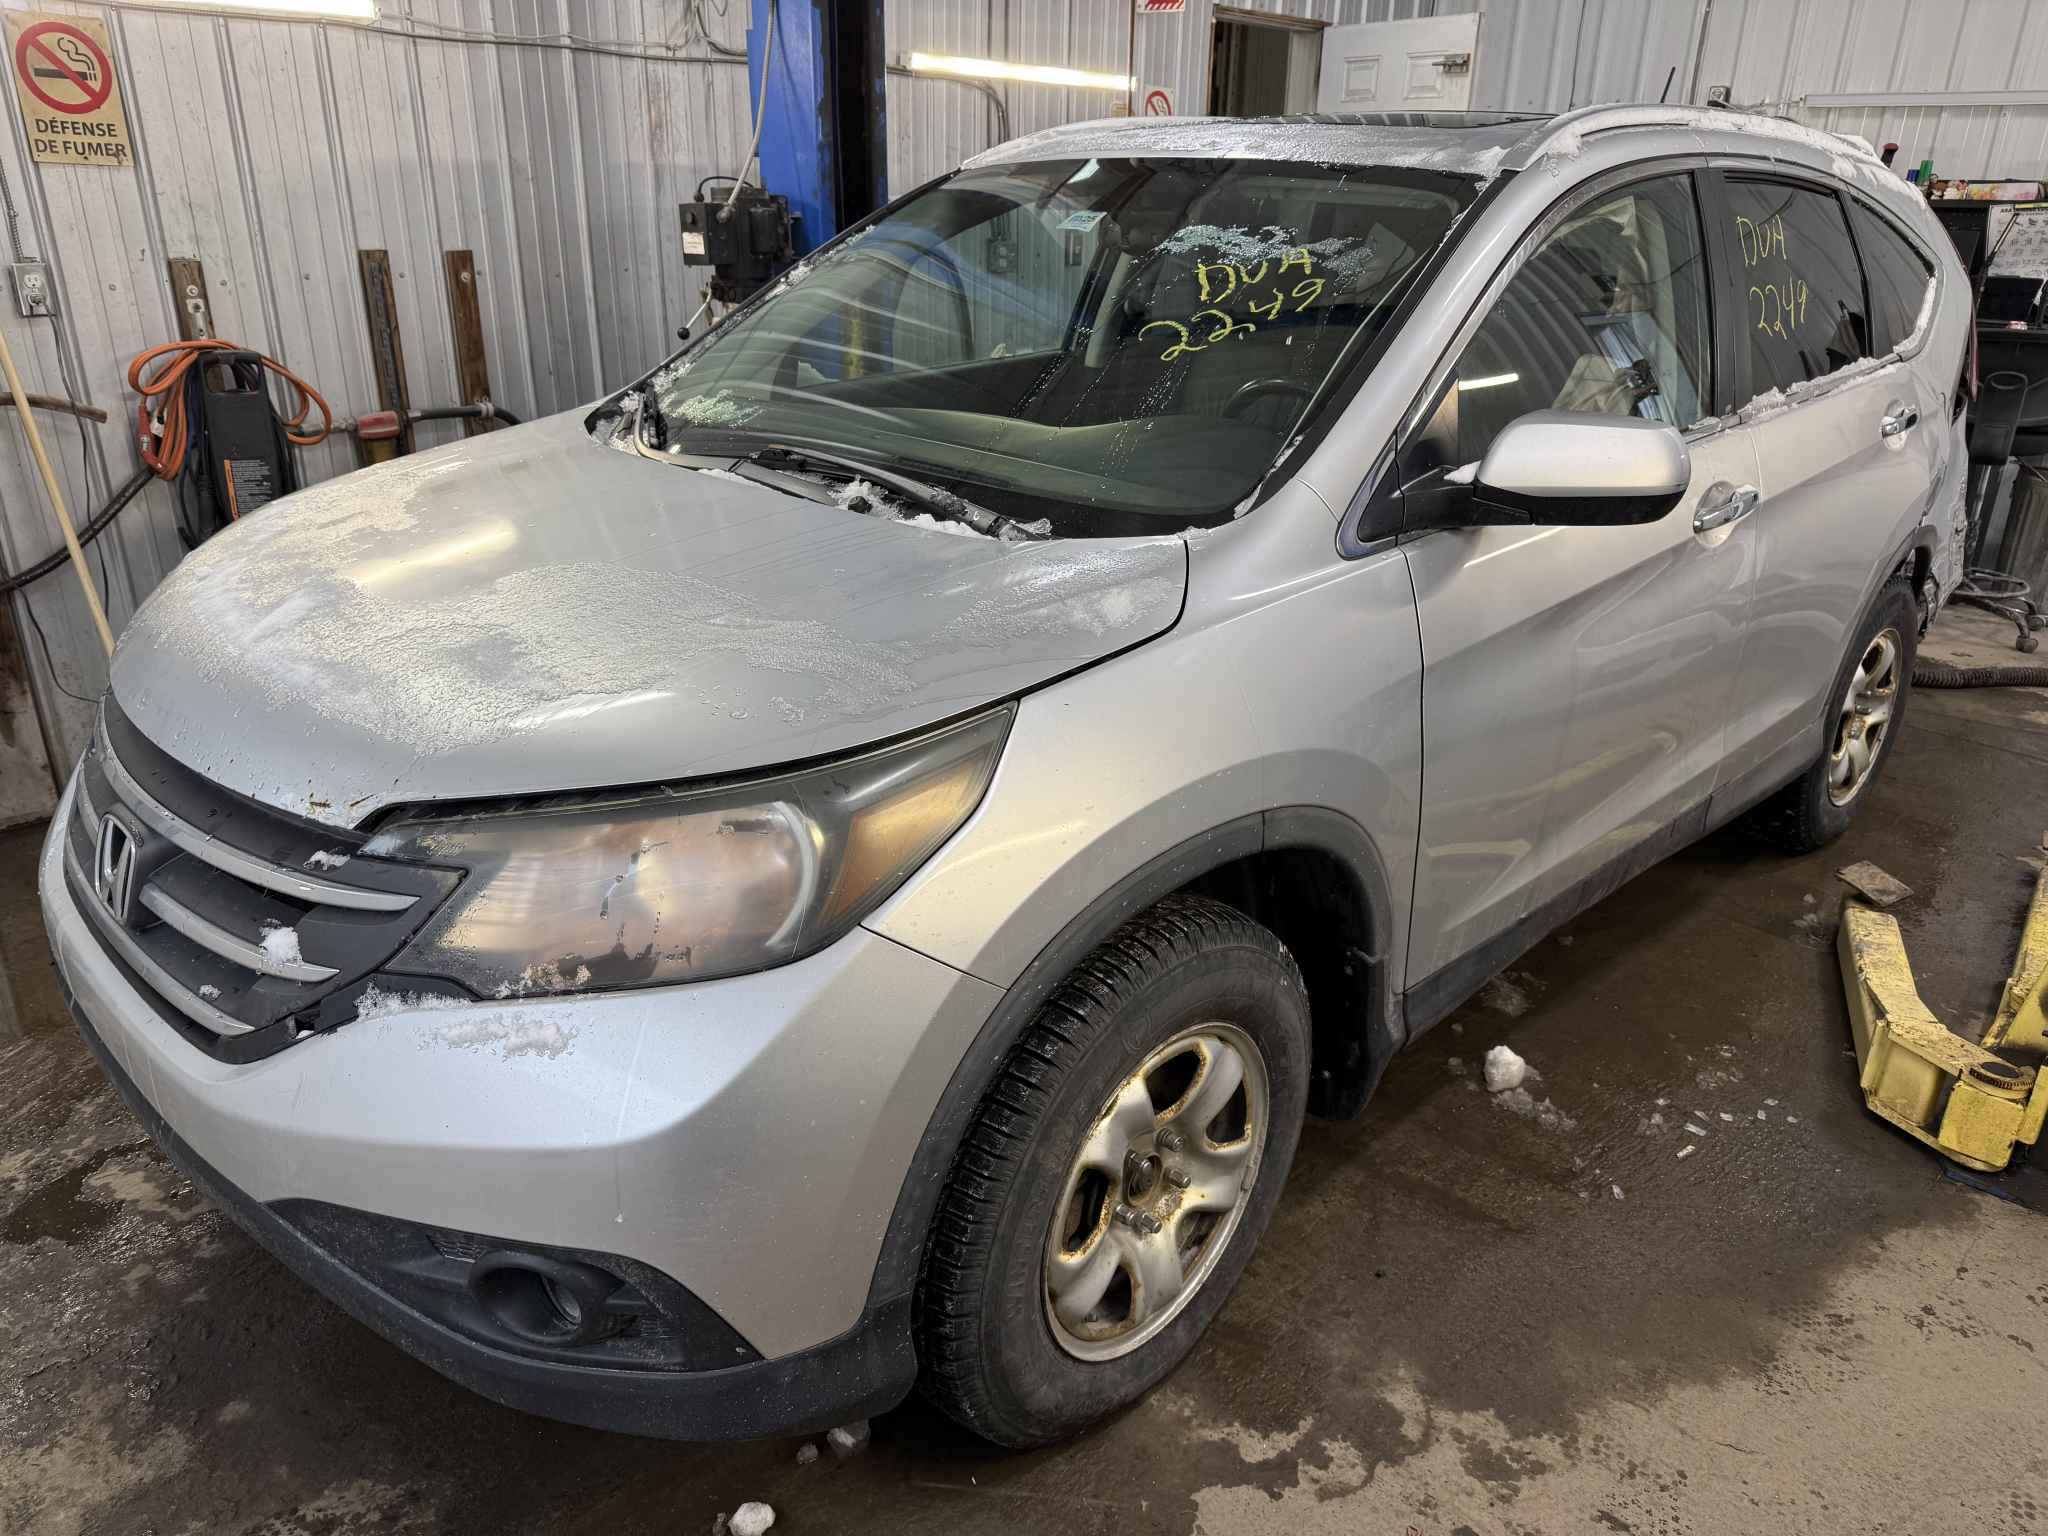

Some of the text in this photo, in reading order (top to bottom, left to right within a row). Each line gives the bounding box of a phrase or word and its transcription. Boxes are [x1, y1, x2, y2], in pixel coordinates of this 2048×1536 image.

[35, 116, 118, 138] DÉFENSE
[34, 138, 127, 158] DE FUMER
[1749, 271, 1809, 341] 2249
